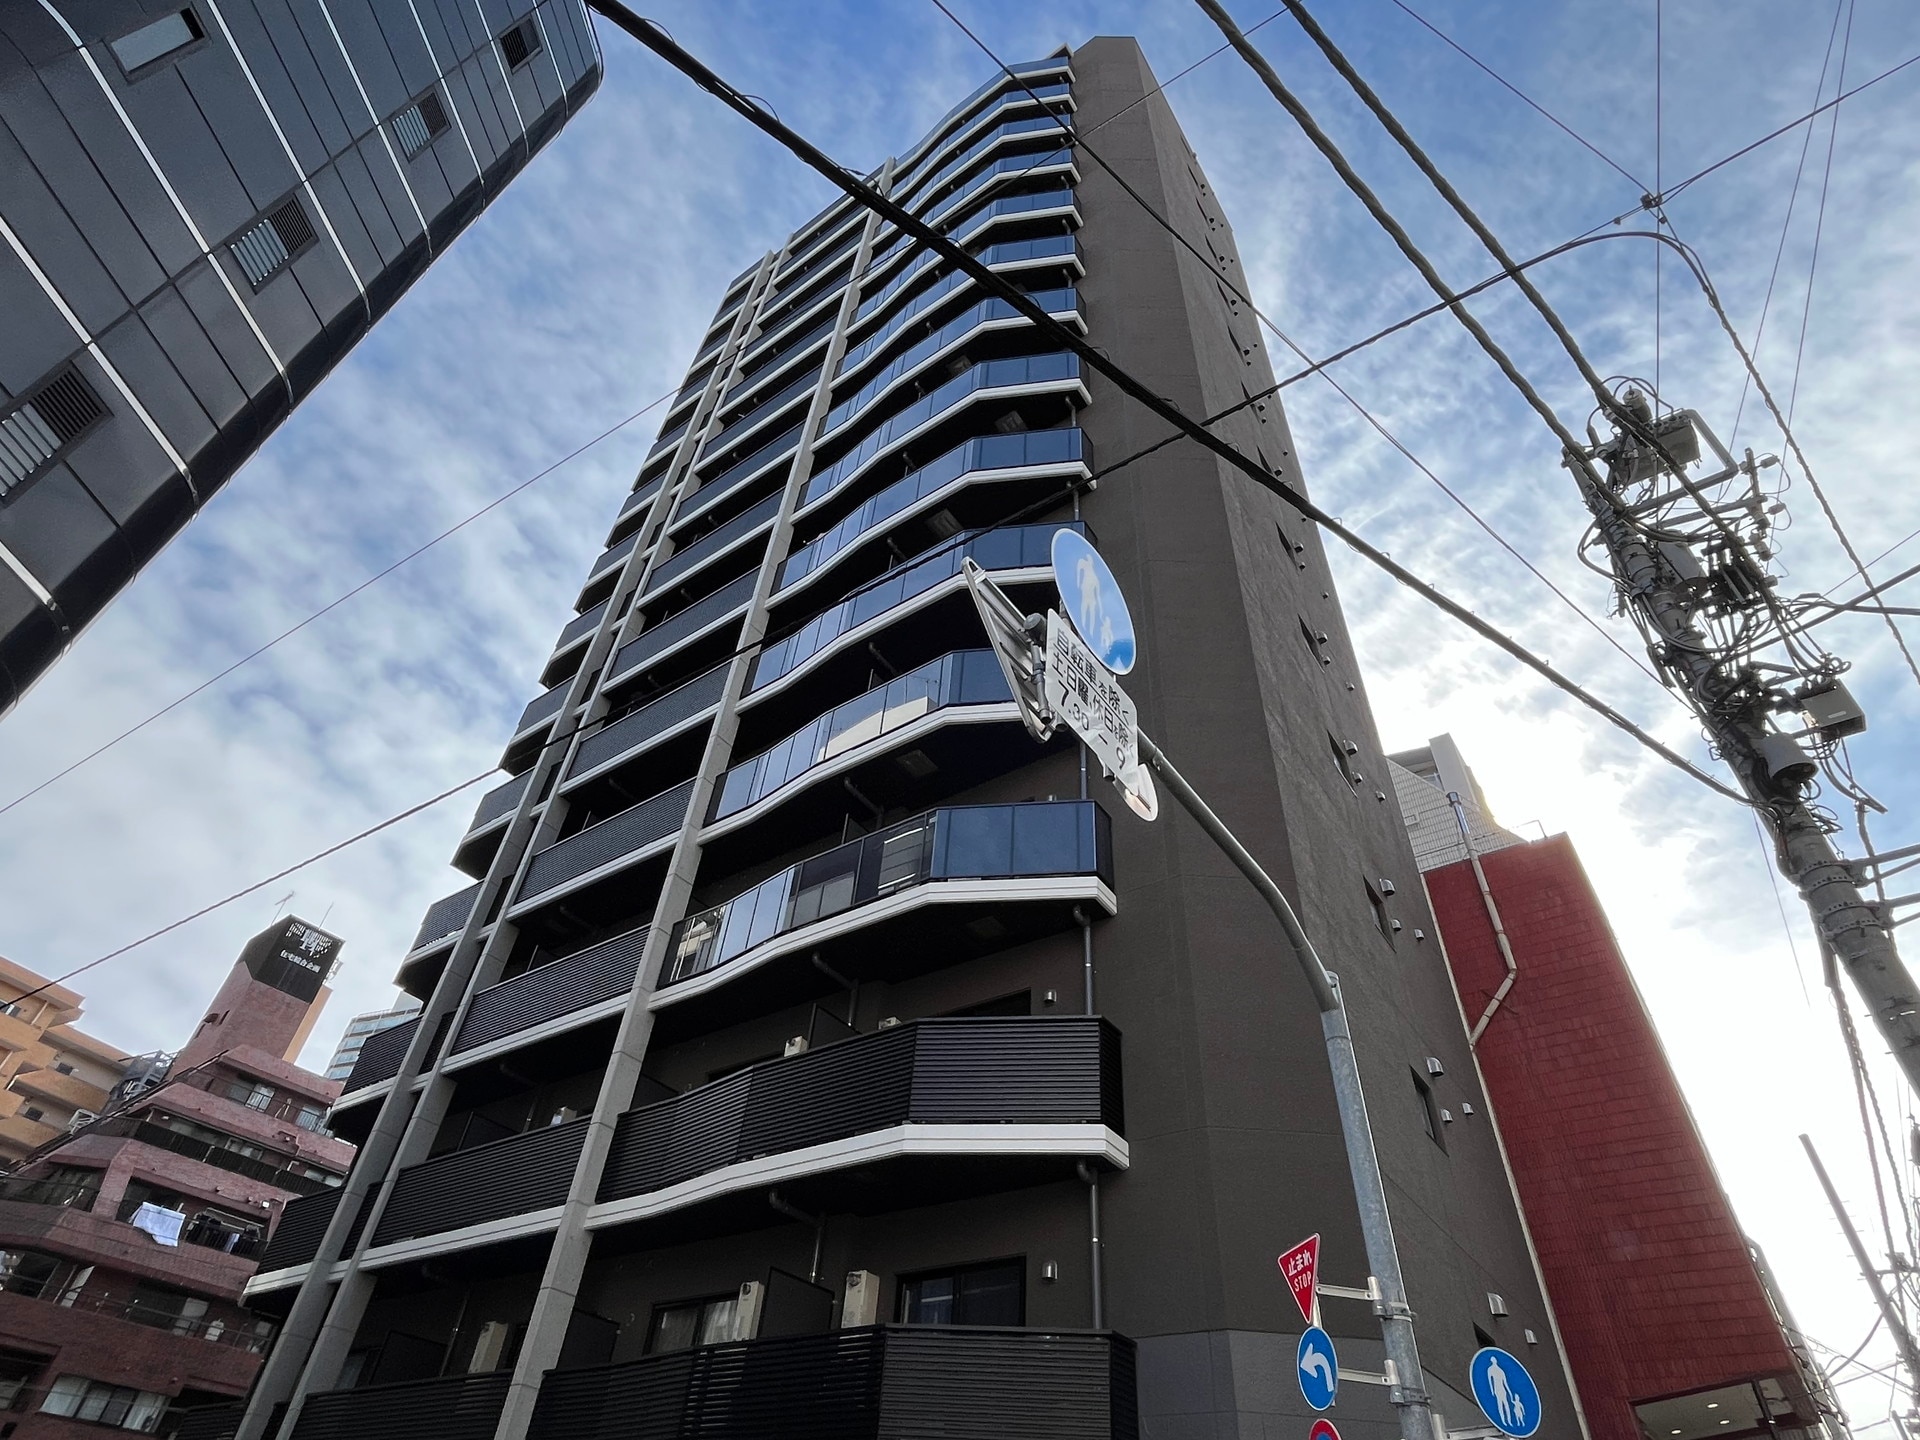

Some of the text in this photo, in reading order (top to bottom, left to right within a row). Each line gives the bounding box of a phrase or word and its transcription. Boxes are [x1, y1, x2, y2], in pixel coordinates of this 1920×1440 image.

[1057, 628, 1129, 726] 自転車を除く
[1288, 1249, 1312, 1277] 止まれ
[1294, 1271, 1312, 1292] STOP
